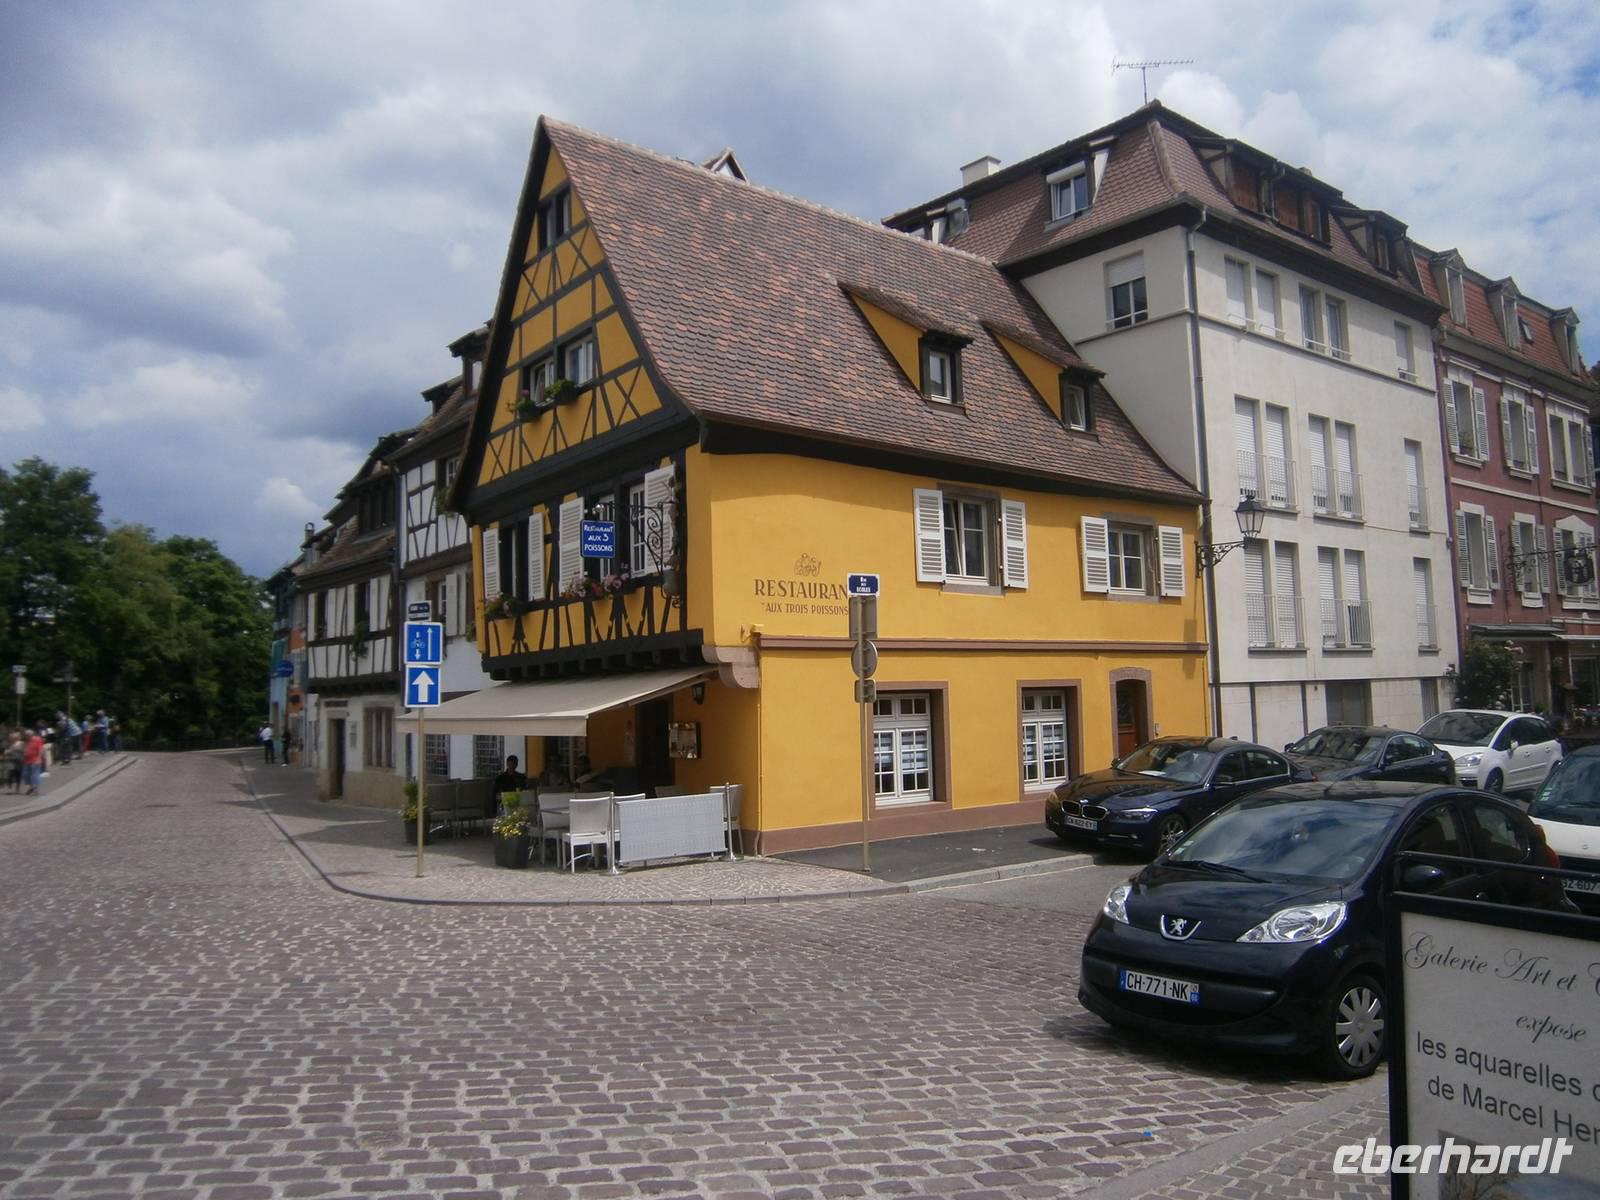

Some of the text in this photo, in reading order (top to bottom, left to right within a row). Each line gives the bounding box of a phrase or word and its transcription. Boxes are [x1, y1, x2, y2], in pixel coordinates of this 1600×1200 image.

[602, 533, 609, 542] 3
[754, 578, 848, 601] RESTAURAN
[784, 603, 809, 614] TROIS
[1404, 932, 1488, 974] Galerie
[1495, 948, 1551, 986] Art
[1556, 974, 1577, 991] et
[1516, 1015, 1587, 1043] expose
[1416, 1031, 1447, 1059] les
[1455, 1047, 1582, 1096] aquarelles
[1427, 1076, 1455, 1100] de
[1463, 1083, 1544, 1129] Marcel
